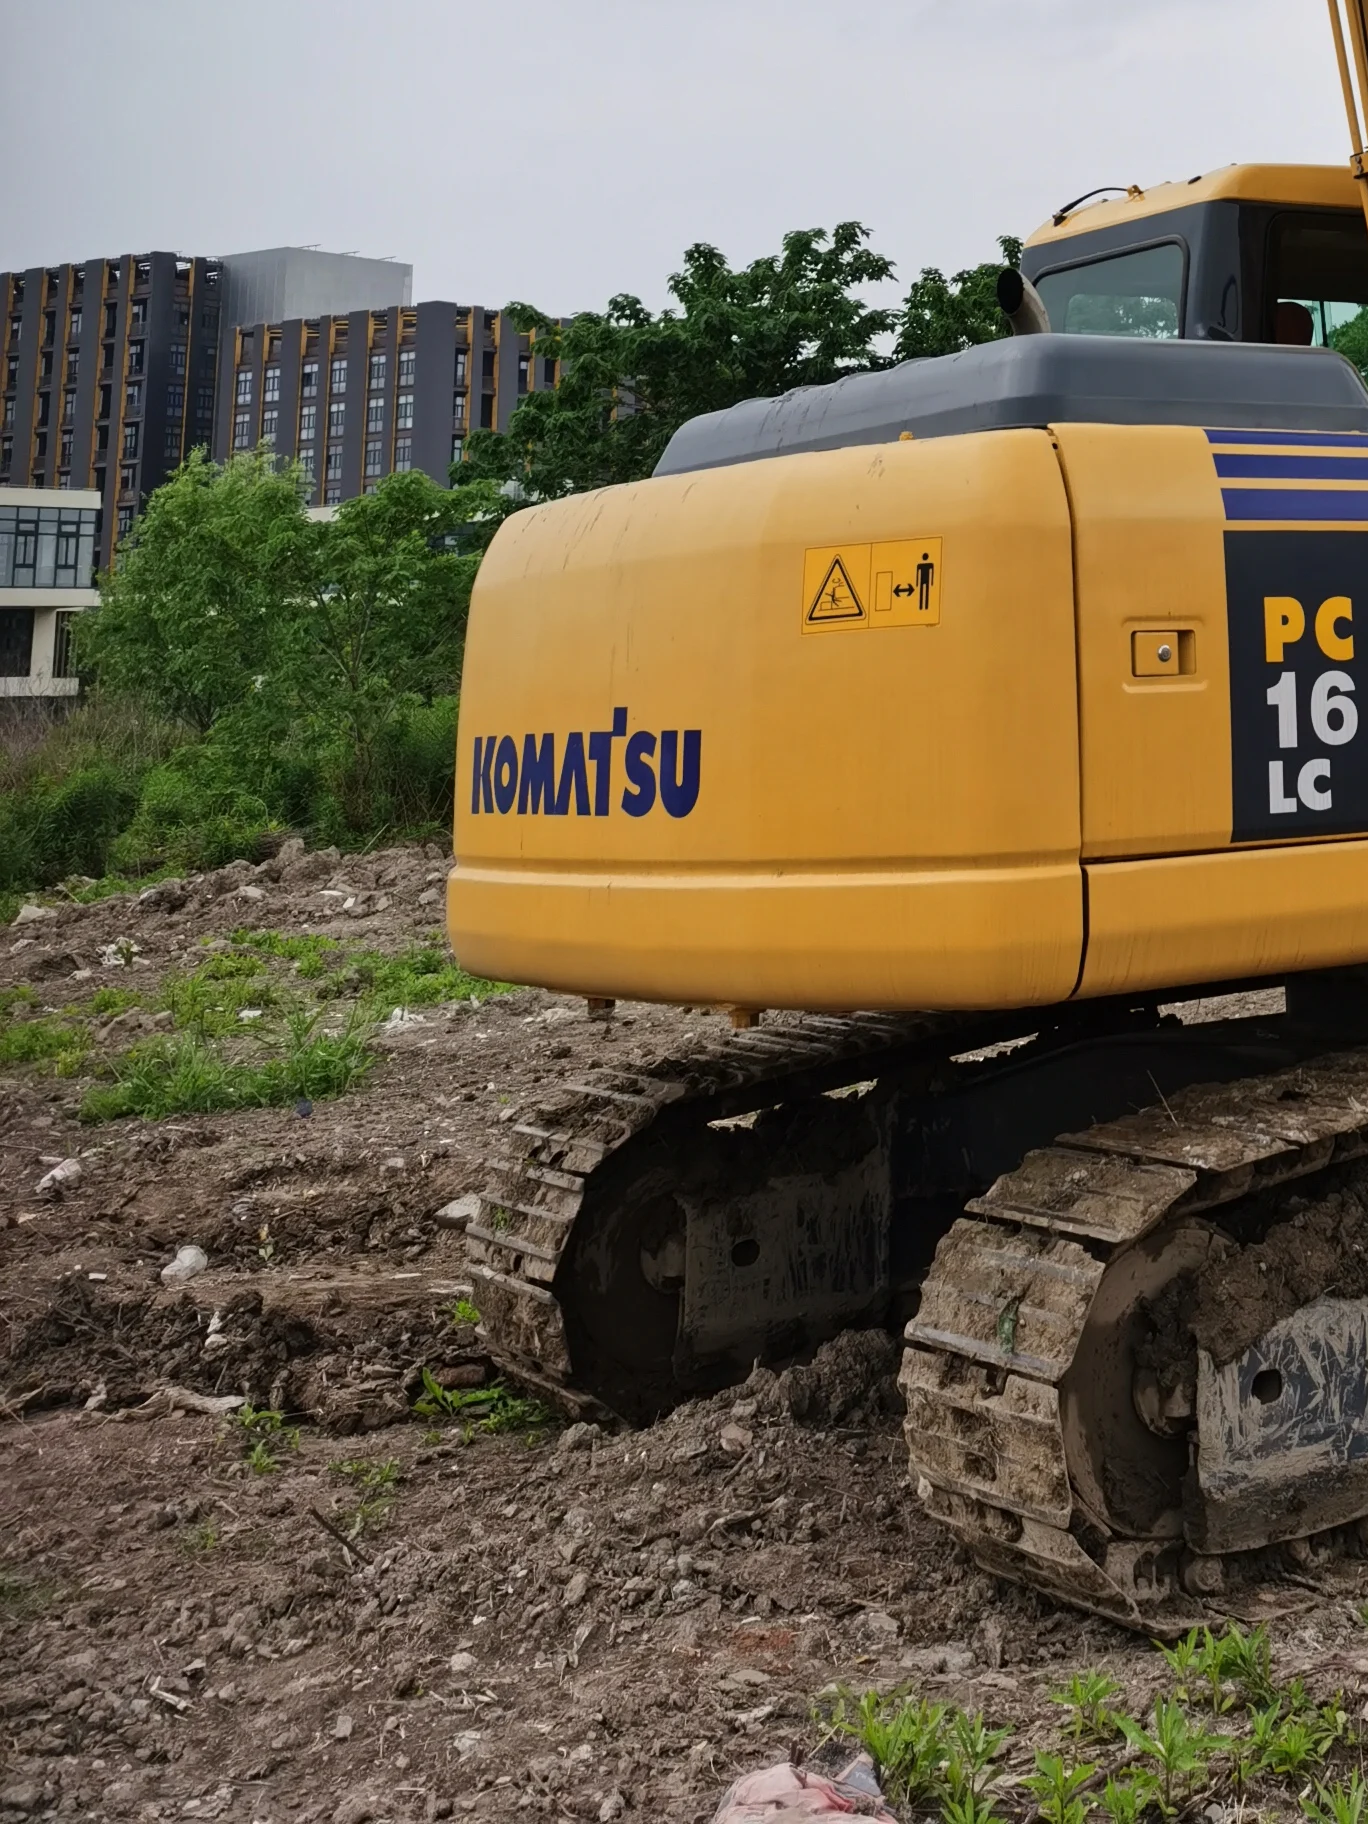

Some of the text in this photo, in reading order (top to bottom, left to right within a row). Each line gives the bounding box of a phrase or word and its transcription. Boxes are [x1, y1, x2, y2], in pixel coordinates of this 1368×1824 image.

[1264, 596, 1354, 662] PC
[471, 707, 701, 818] KOMATSU
[1268, 758, 1332, 814] LC
